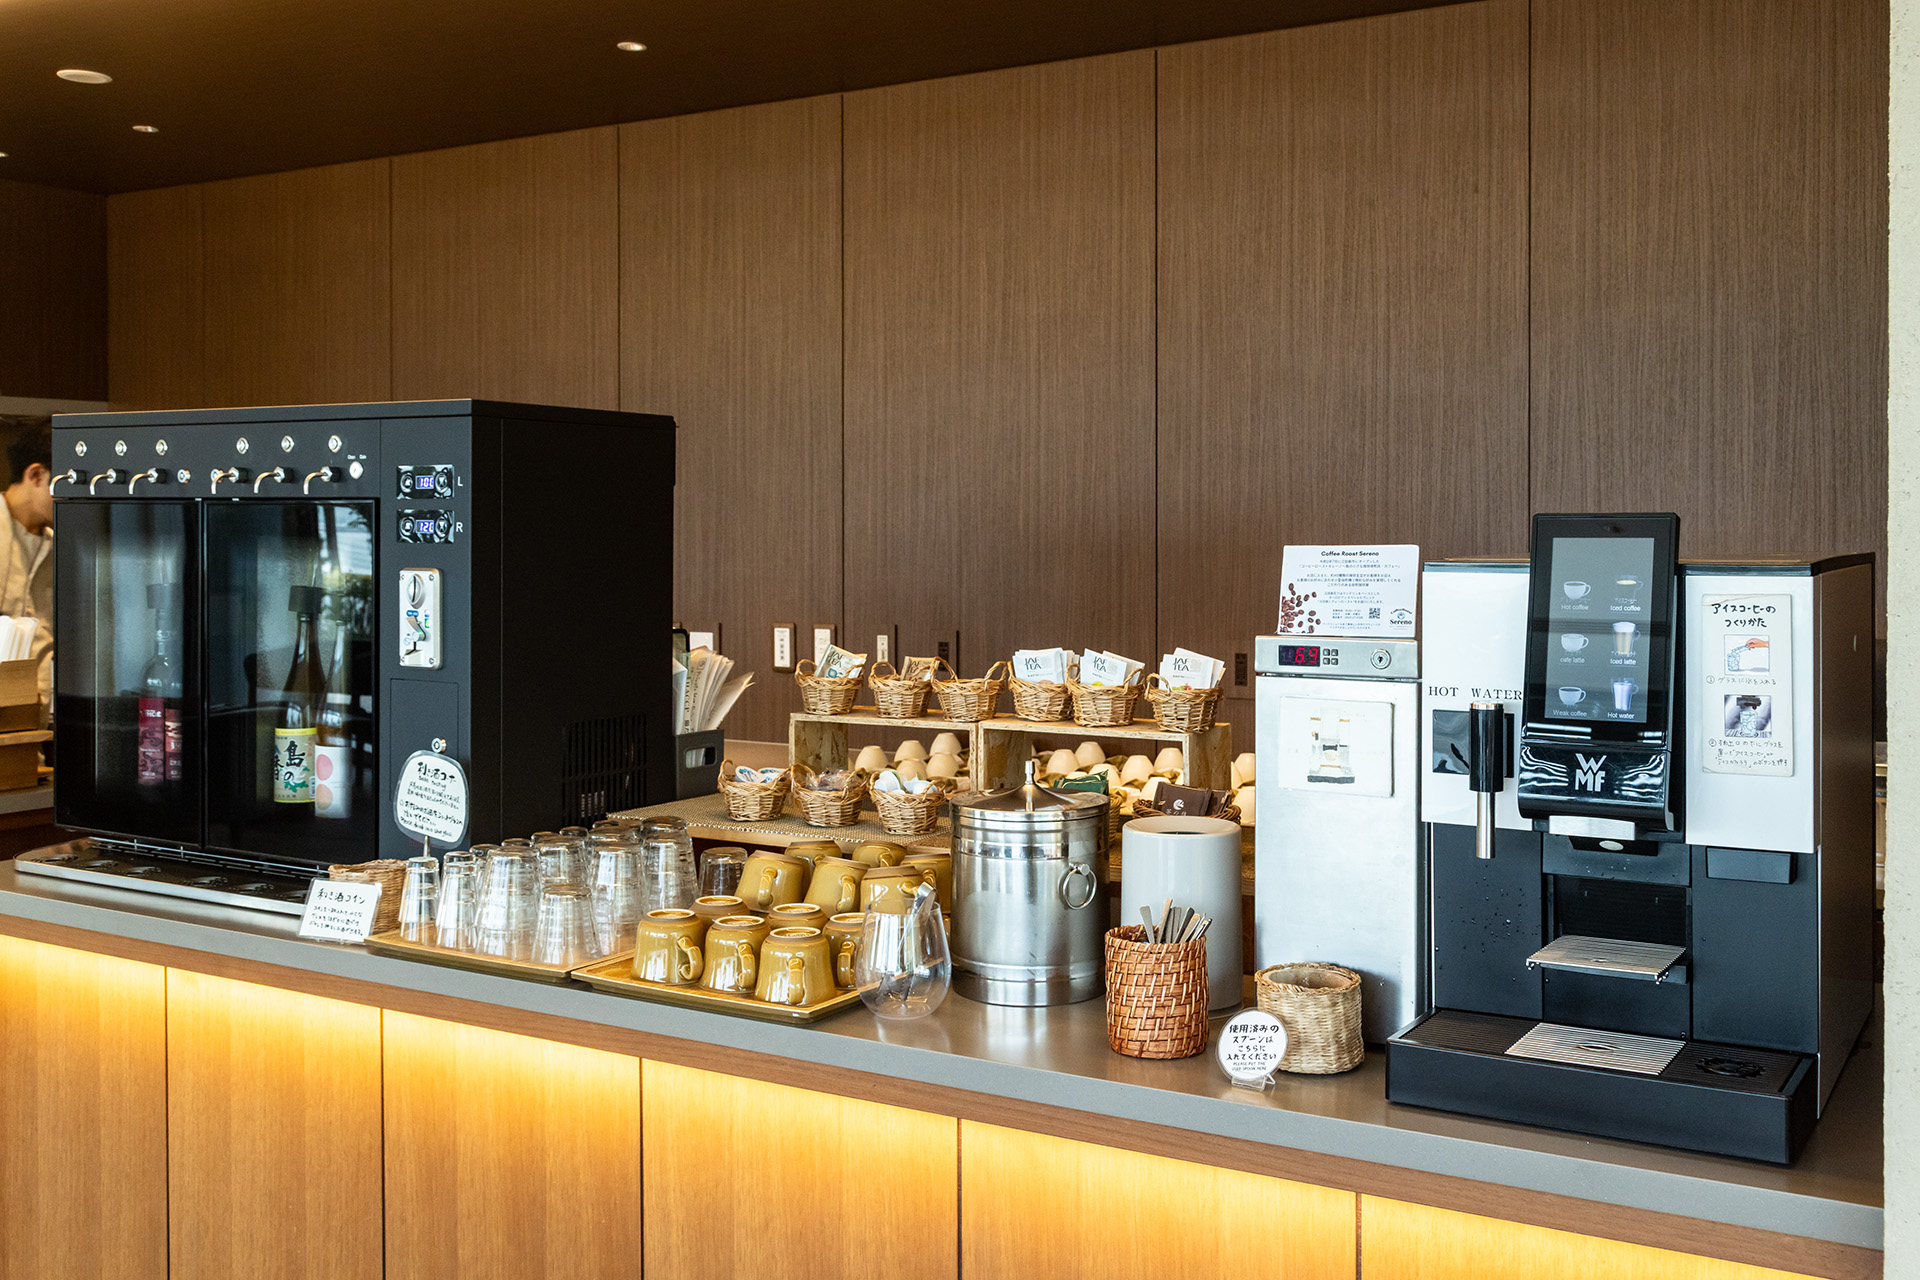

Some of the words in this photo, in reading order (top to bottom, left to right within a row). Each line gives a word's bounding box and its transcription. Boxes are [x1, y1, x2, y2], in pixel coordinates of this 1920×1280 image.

[457, 476, 463, 487] L
[455, 522, 463, 532] R
[1711, 603, 1776, 614] アイスコーヒーの
[1724, 618, 1767, 628] つくりかた
[1295, 647, 1319, 663] 6.9
[1025, 663, 1042, 671] TEA
[1093, 662, 1107, 673] TEA
[1173, 664, 1190, 672] TEA
[1428, 686, 1460, 697] HOT
[1470, 688, 1523, 701] WATER
[1574, 752, 1608, 793] WMF
[1229, 1024, 1280, 1034] 使用済みの
[1232, 1035, 1274, 1044] スプーンは
[1226, 1053, 1277, 1061] 入れてください
